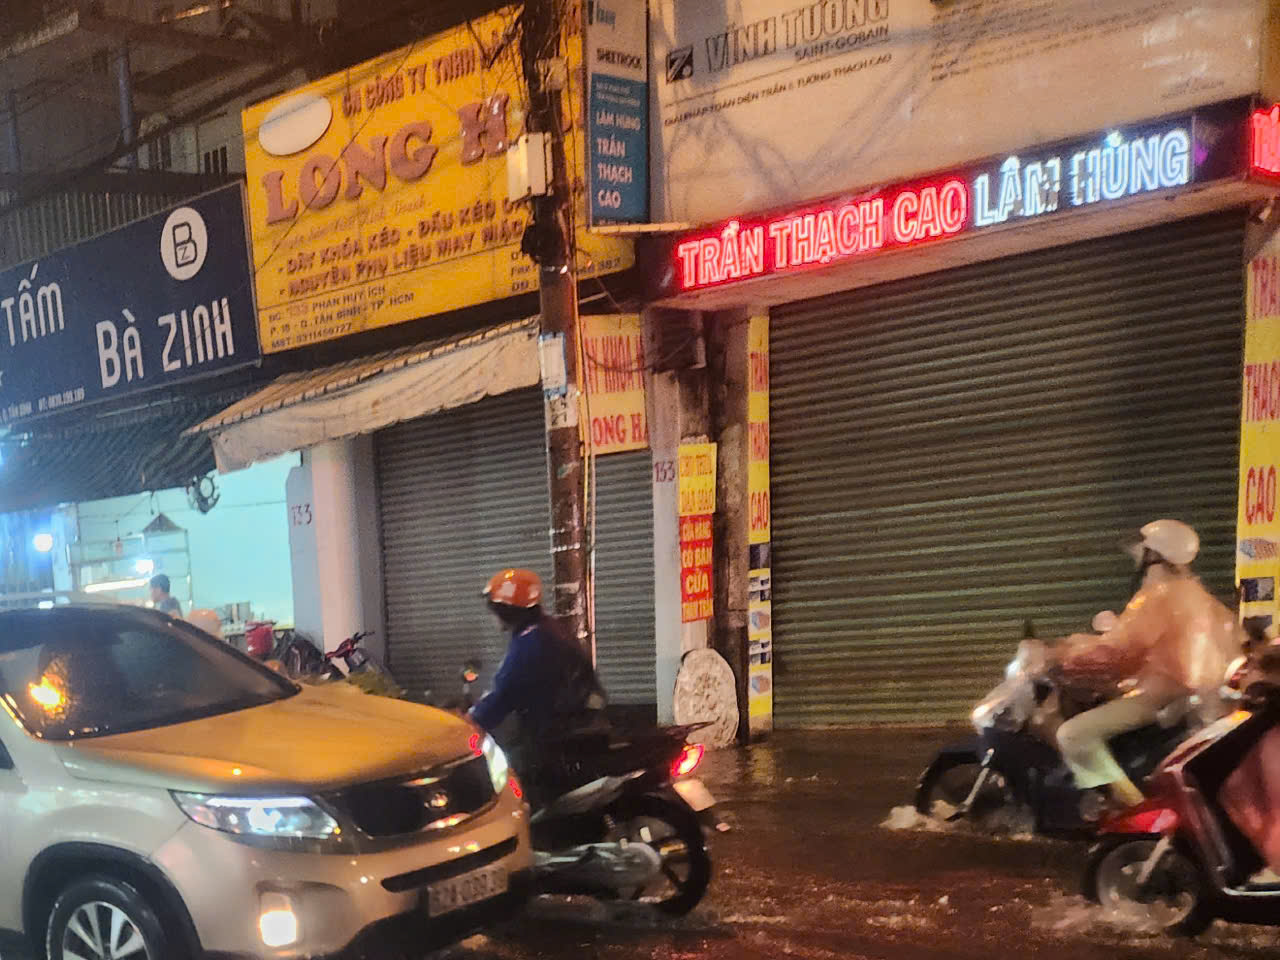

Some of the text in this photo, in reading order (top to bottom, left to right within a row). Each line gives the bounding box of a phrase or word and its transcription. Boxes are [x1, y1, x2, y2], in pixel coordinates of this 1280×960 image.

[795, 23, 889, 62] SAINT-GOBAIN
[408, 63, 428, 95] TY
[432, 48, 475, 86] TNHH
[261, 120, 438, 226] LONG
[597, 163, 632, 186] THẠCH
[598, 189, 621, 208] CAO
[770, 198, 883, 268] THẠCH
[894, 180, 967, 242] CAO
[974, 155, 1061, 226] LÂM
[368, 226, 400, 251] KÉO
[459, 198, 496, 226] KÉO
[96, 298, 234, 389] BÀ ZINH
